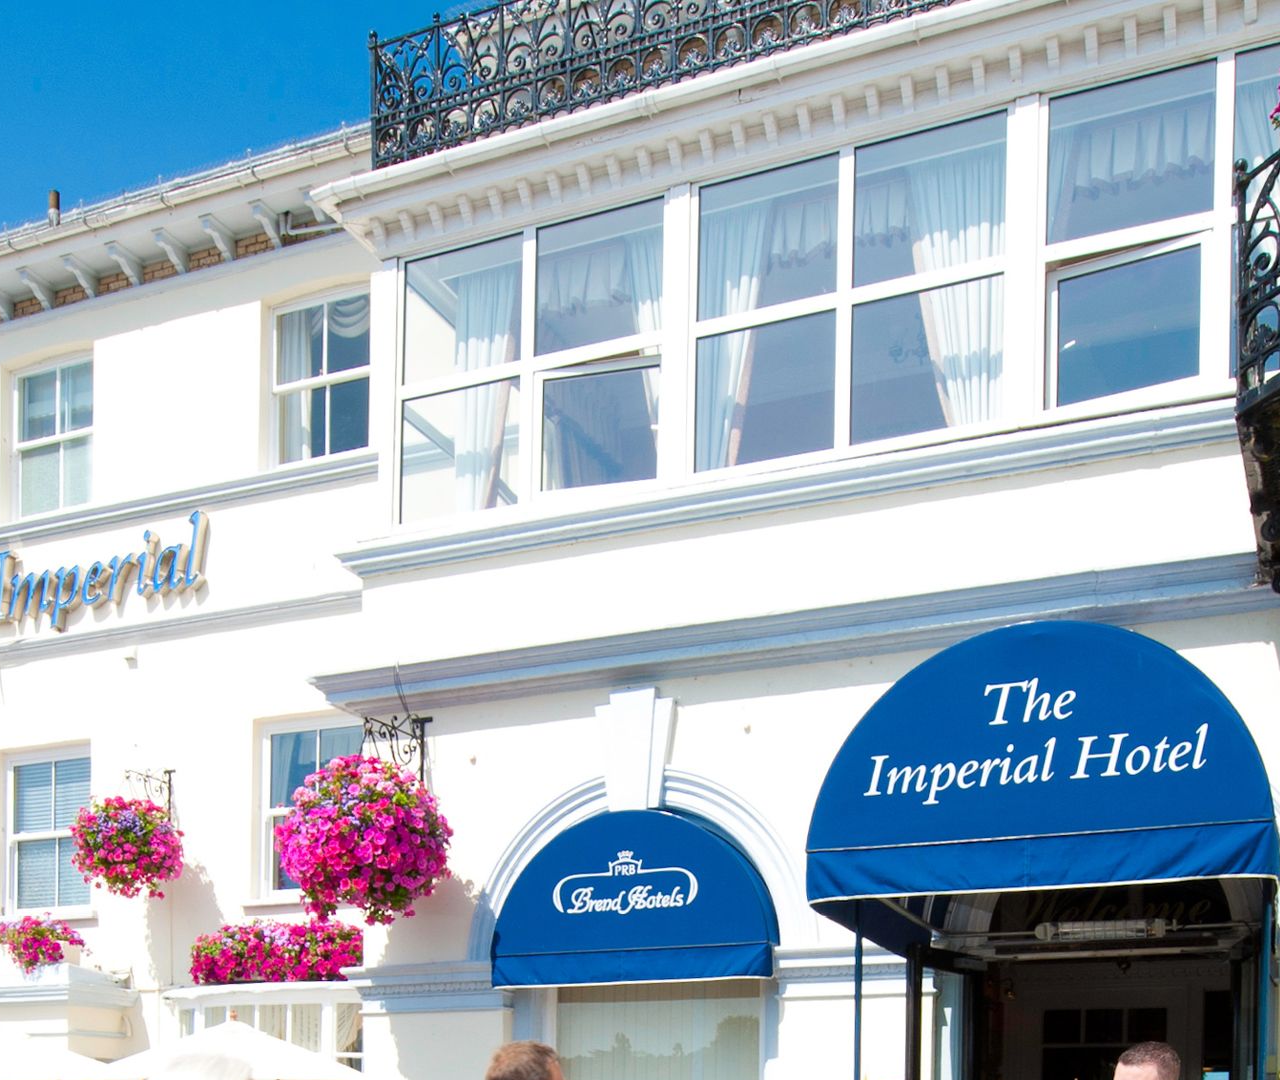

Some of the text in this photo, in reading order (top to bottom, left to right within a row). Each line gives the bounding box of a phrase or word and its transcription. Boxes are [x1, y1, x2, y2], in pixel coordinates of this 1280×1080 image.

[983, 677, 1077, 726] The
[863, 722, 1210, 806] Imperial Hotel
[614, 864, 636, 876] PRB
[566, 885, 685, 914] Brend Hotels
